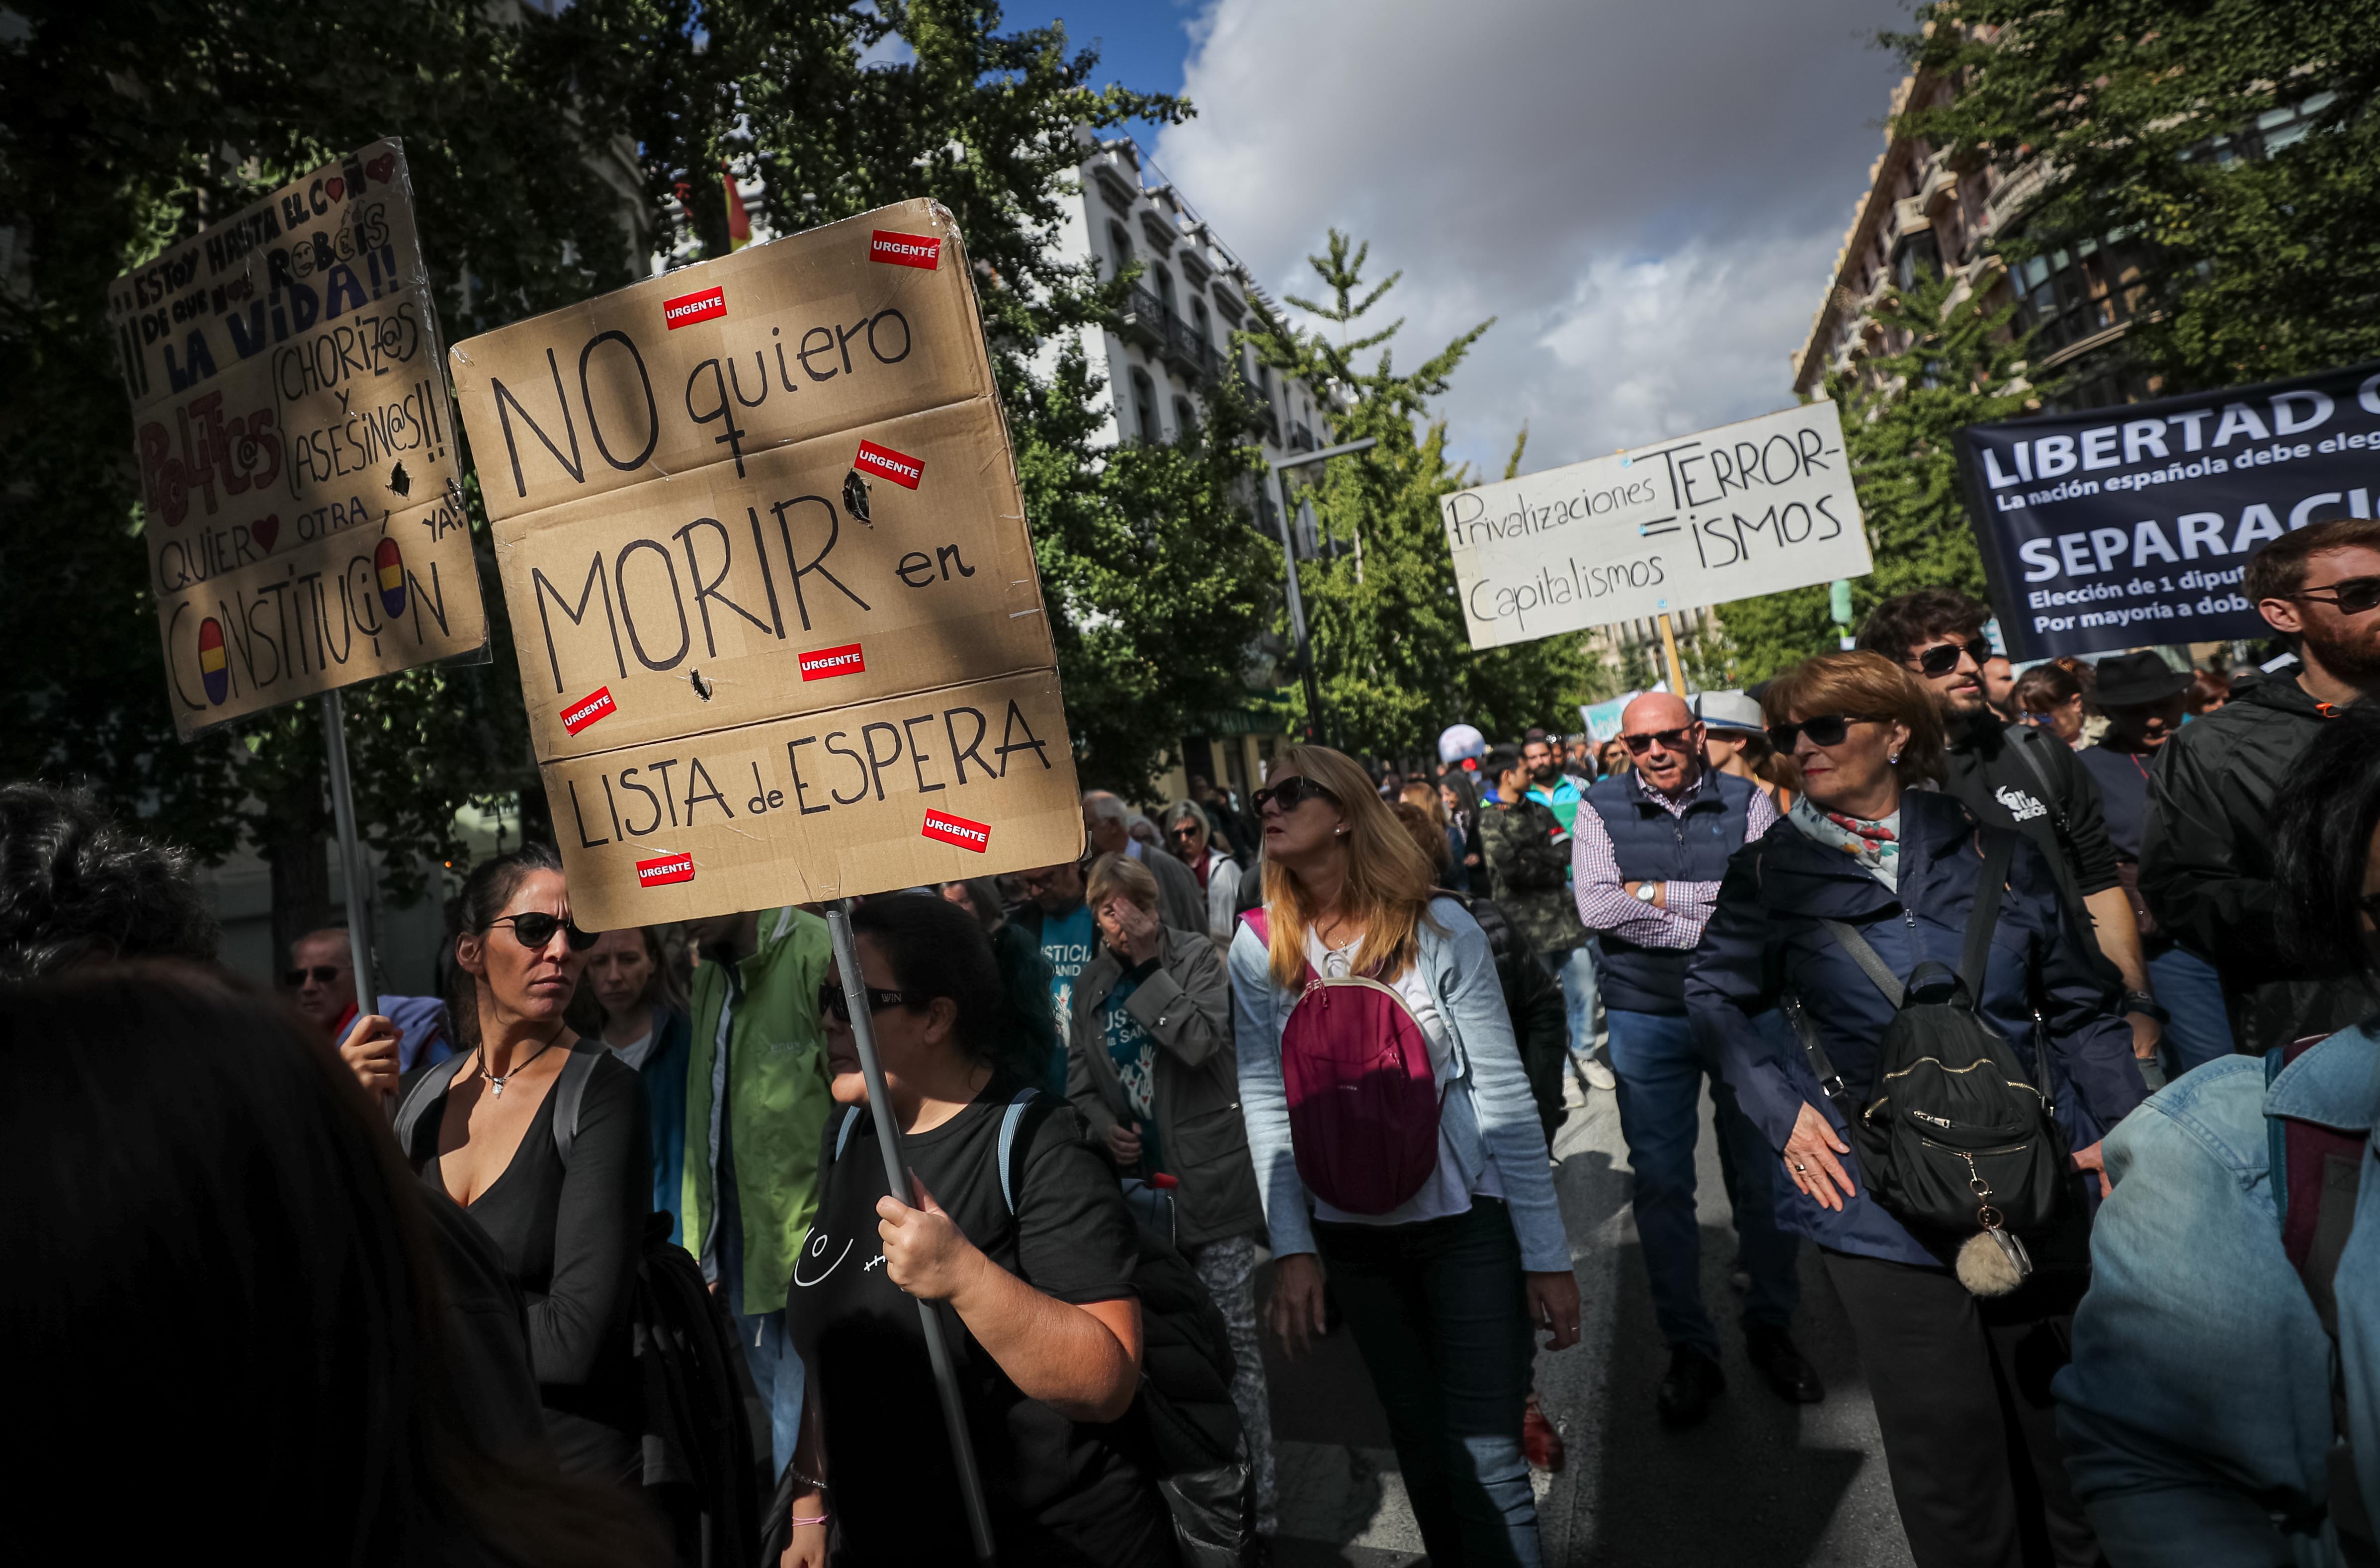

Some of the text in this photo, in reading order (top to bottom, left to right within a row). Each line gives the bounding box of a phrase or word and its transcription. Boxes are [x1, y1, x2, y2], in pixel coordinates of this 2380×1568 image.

[205, 206, 281, 275] HASTA
[872, 240, 936, 259] URGENTE
[142, 307, 170, 346] DE
[172, 288, 208, 324] QUE
[666, 296, 722, 319] URGENTE
[163, 328, 218, 394] LA
[335, 388, 349, 415] Y
[491, 308, 911, 497] NO quiero
[1983, 390, 2334, 489] LIBERTAD
[858, 449, 919, 479] URGENTE
[1997, 495, 2026, 512] La
[2028, 479, 2100, 505] nación
[2105, 456, 2228, 491] española
[2234, 443, 2311, 469] debe
[1447, 428, 1840, 545] Privatizaciones TERROR-
[298, 497, 368, 540] OTRA
[2019, 487, 2380, 583] SEPARACI
[532, 495, 976, 694] MORIR en
[1471, 556, 1664, 631] Capitalismos
[2028, 583, 2125, 610] Elección
[2127, 578, 2156, 597] de
[2159, 576, 2174, 591] 1
[2034, 592, 2254, 634] Por mayoría a dob
[801, 652, 860, 671] URGENTE
[564, 695, 611, 727] URGENTE
[568, 699, 1052, 848] LISTA de ESPERA
[926, 818, 986, 843] URGENTE
[639, 861, 691, 879] URGENTE
[1041, 944, 1092, 962] STICI
